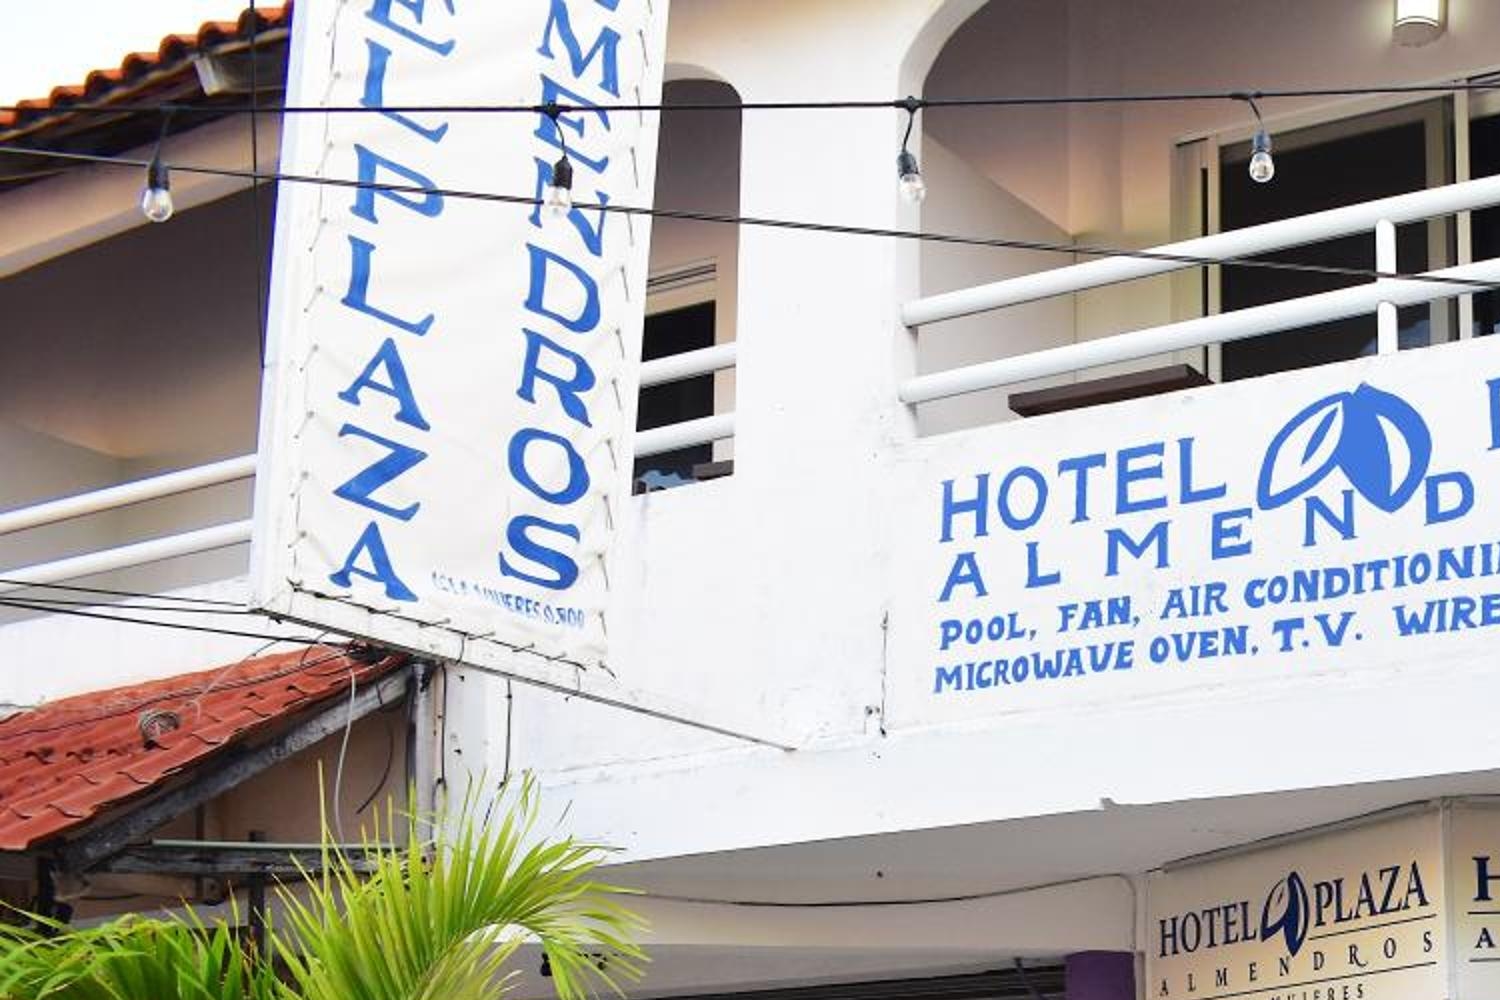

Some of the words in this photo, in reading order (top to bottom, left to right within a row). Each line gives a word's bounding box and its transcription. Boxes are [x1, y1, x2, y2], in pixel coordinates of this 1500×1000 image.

[499, 0, 622, 591] MENDROS
[329, 143, 445, 602] PLAZA
[939, 437, 1227, 543] HOTEL
[933, 640, 1134, 694] MICROWAVE
[1272, 611, 1363, 652] T.V.
[939, 612, 1037, 650] POOL,
[1057, 595, 1140, 633] FAN,
[1160, 581, 1229, 621] AIR
[1159, 901, 1258, 958] HOTEL
[1313, 860, 1430, 928] PLAZA
[1159, 931, 1434, 998] ALMENDROS
